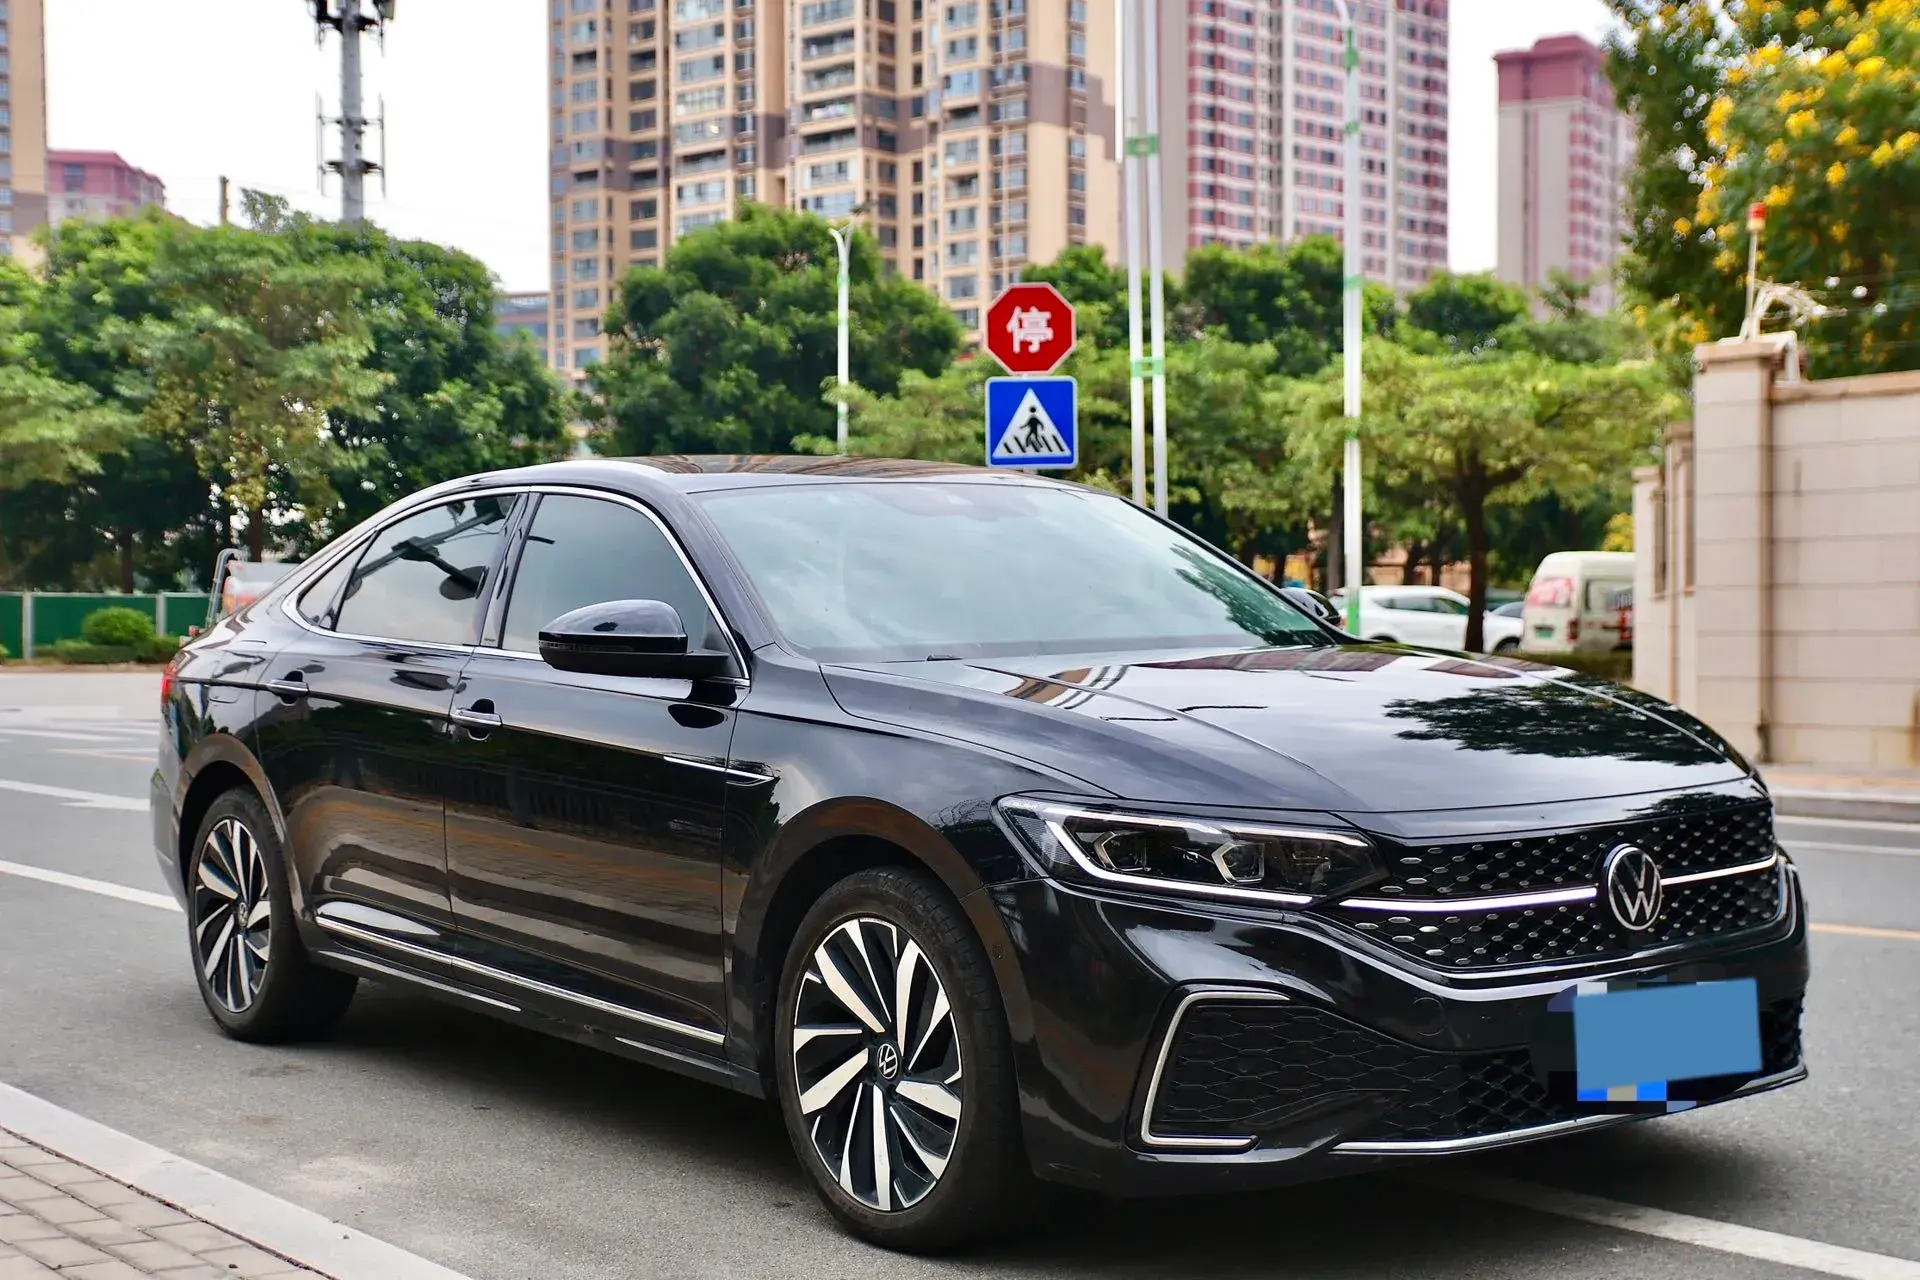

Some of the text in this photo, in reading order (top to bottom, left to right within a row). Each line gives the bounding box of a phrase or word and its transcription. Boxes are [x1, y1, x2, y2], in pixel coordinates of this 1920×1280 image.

[1006, 305, 1054, 354] 停
[1609, 848, 1661, 929] VW
[878, 1044, 897, 1079] VW
